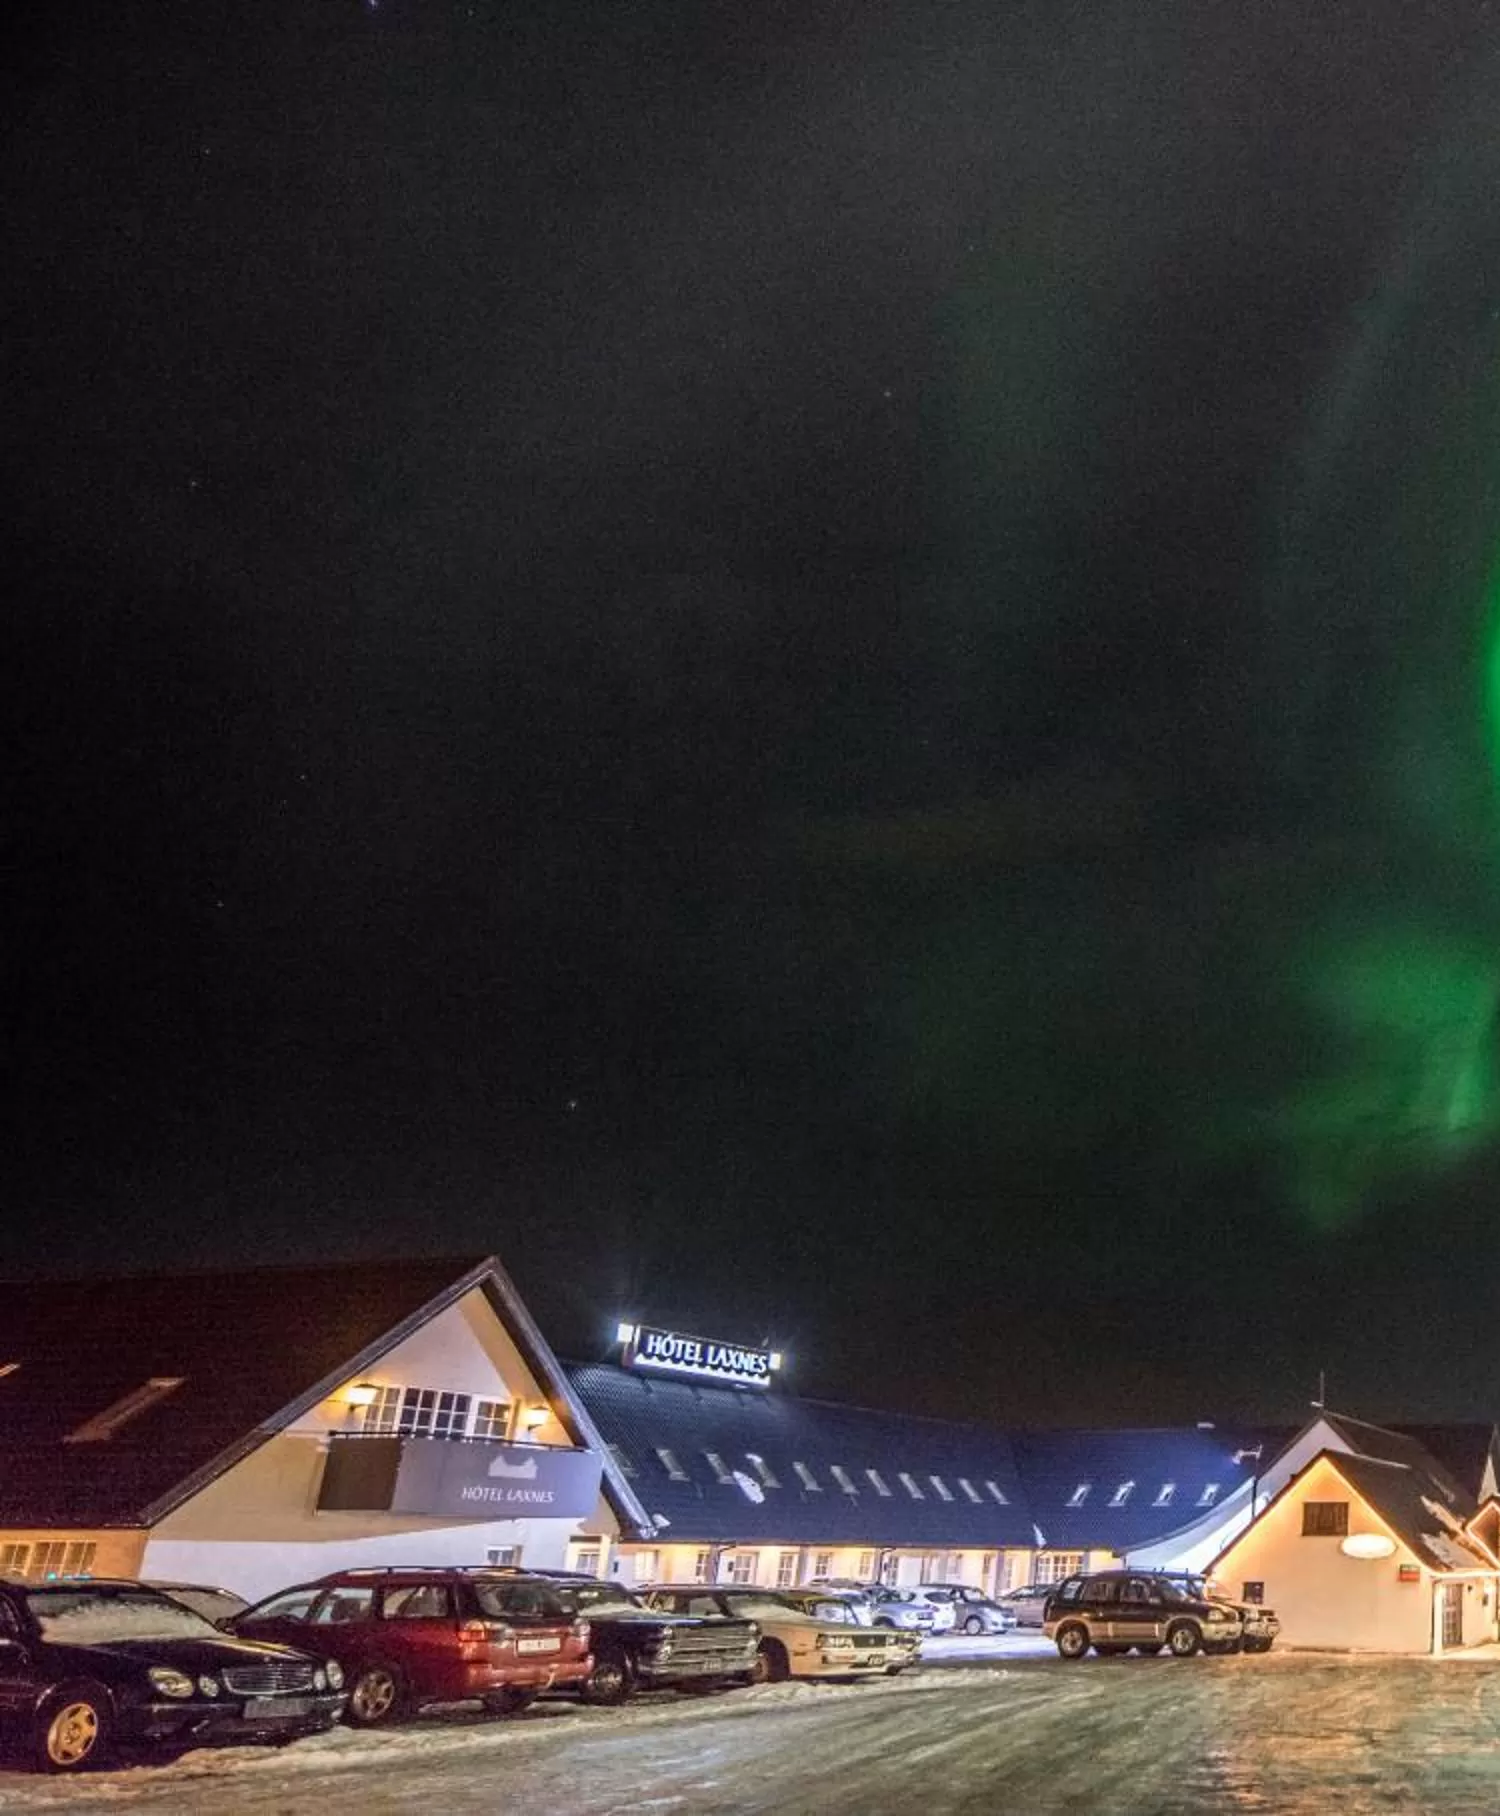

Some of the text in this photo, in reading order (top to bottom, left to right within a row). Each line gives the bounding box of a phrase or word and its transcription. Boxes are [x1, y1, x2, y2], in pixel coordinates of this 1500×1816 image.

[646, 1331, 767, 1373] HÓTEL LAXNES
[507, 1489, 555, 1503] LAXNES
